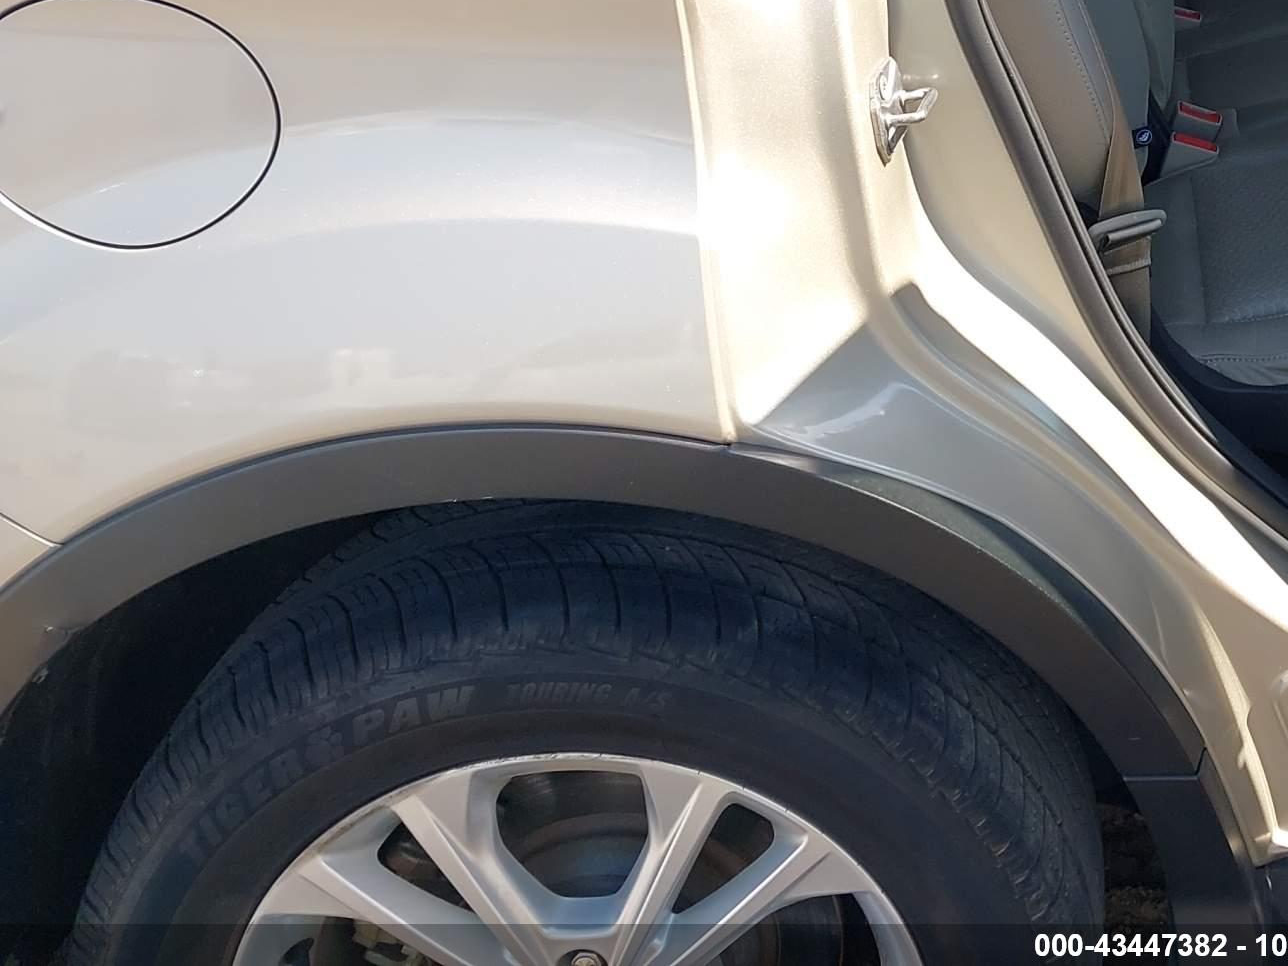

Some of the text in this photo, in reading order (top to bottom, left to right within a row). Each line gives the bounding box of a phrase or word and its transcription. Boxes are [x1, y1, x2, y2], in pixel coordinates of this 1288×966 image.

[505, 681, 613, 706] TOURING
[178, 684, 477, 866] TIGER PAW
